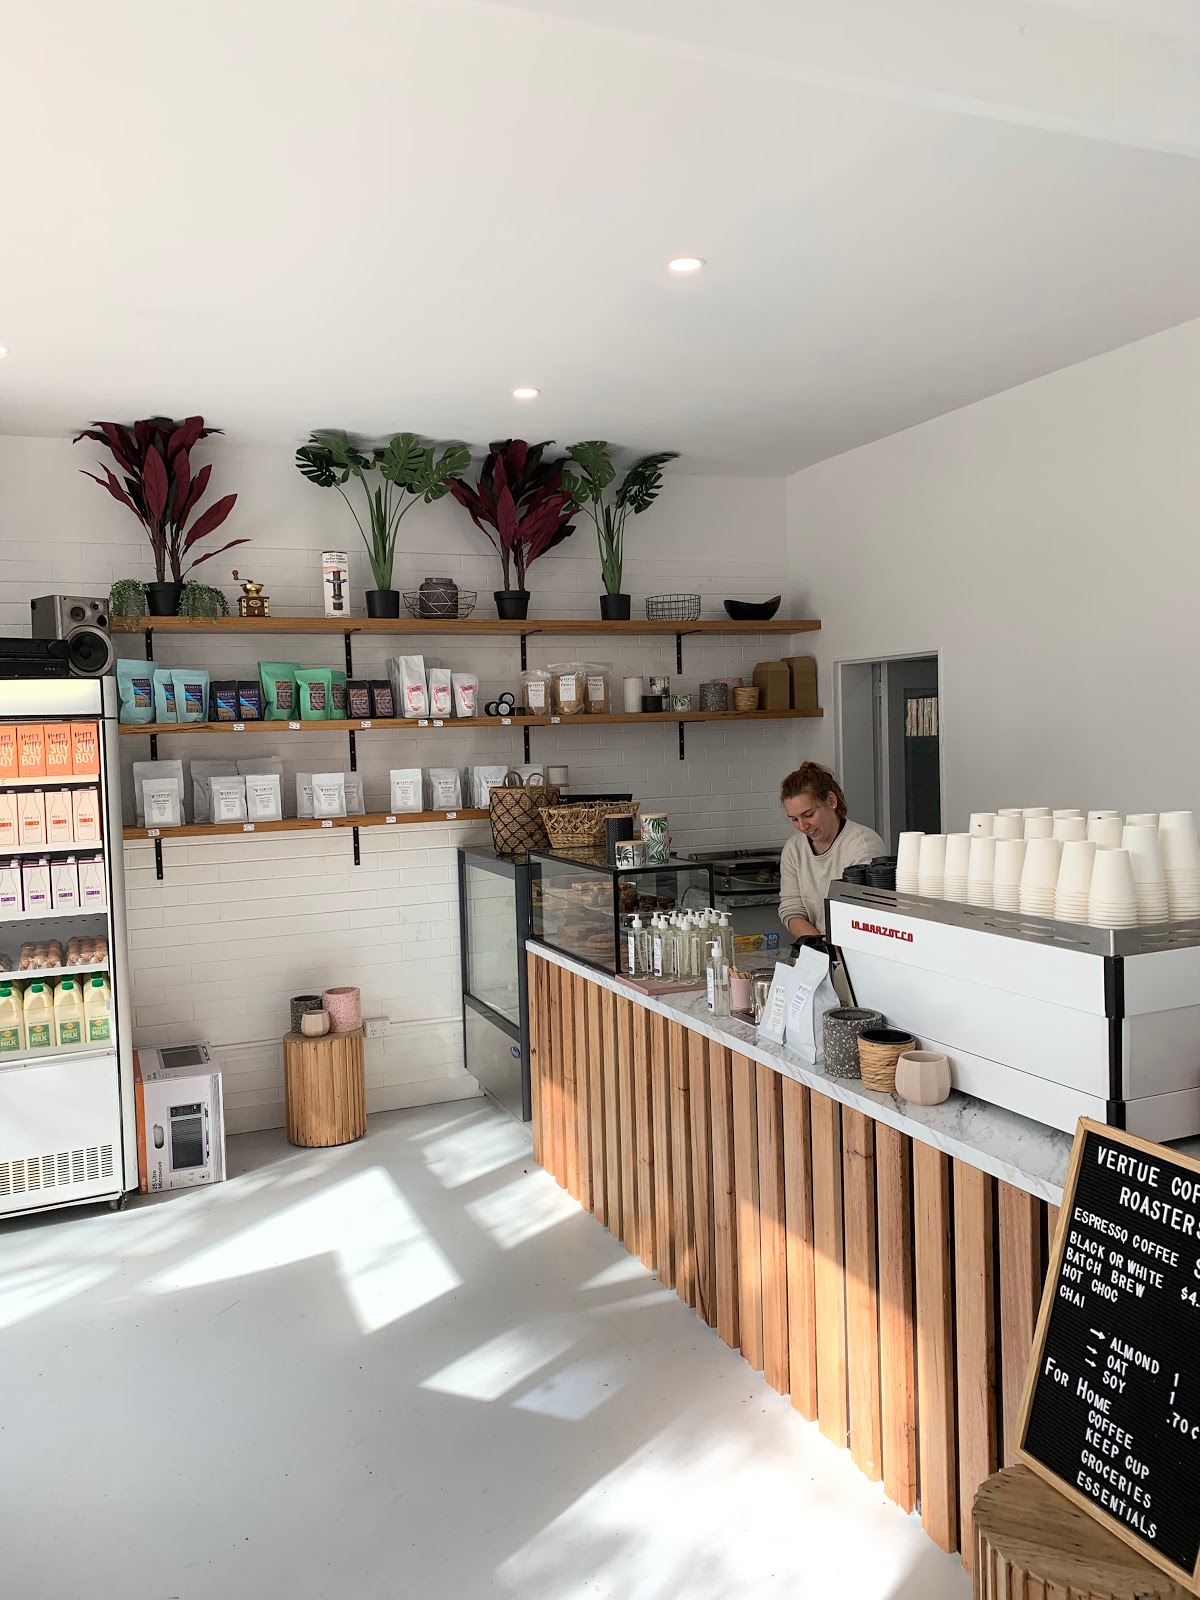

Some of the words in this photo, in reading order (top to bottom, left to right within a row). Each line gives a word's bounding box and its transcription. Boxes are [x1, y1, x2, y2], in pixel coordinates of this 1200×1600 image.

[0, 746, 15, 757] OY
[21, 755, 42, 766] BOY
[22, 745, 43, 756] SOY
[48, 754, 68, 765] BOY
[49, 744, 69, 755] SOY
[75, 753, 95, 764] BOY
[76, 743, 96, 754] SOY
[0, 756, 14, 767] OY
[1097, 1145, 1161, 1188] VERTUE
[1074, 1207, 1129, 1244] ESPRESSO
[1132, 1234, 1180, 1268] COFFEE
[1066, 1246, 1102, 1276] BATCH
[1110, 1269, 1146, 1298] BREW
[1069, 1230, 1106, 1260] BLACK
[1109, 1251, 1124, 1269] OR
[1127, 1259, 1164, 1289] WHITE
[1062, 1262, 1084, 1284] HOT
[1091, 1278, 1119, 1303] CHOC
[1059, 1284, 1086, 1309] CHAI
[1106, 1354, 1129, 1377] OAT
[1109, 1337, 1160, 1375] ALMOND
[1102, 1370, 1127, 1394] SOY
[1088, 1409, 1134, 1450] COFFEE
[1085, 1427, 1120, 1459] KEEP
[1125, 1455, 1150, 1480] CUP
[1081, 1449, 1152, 1509] GROCERIES
[1076, 1470, 1157, 1539] ESSENTIALS
